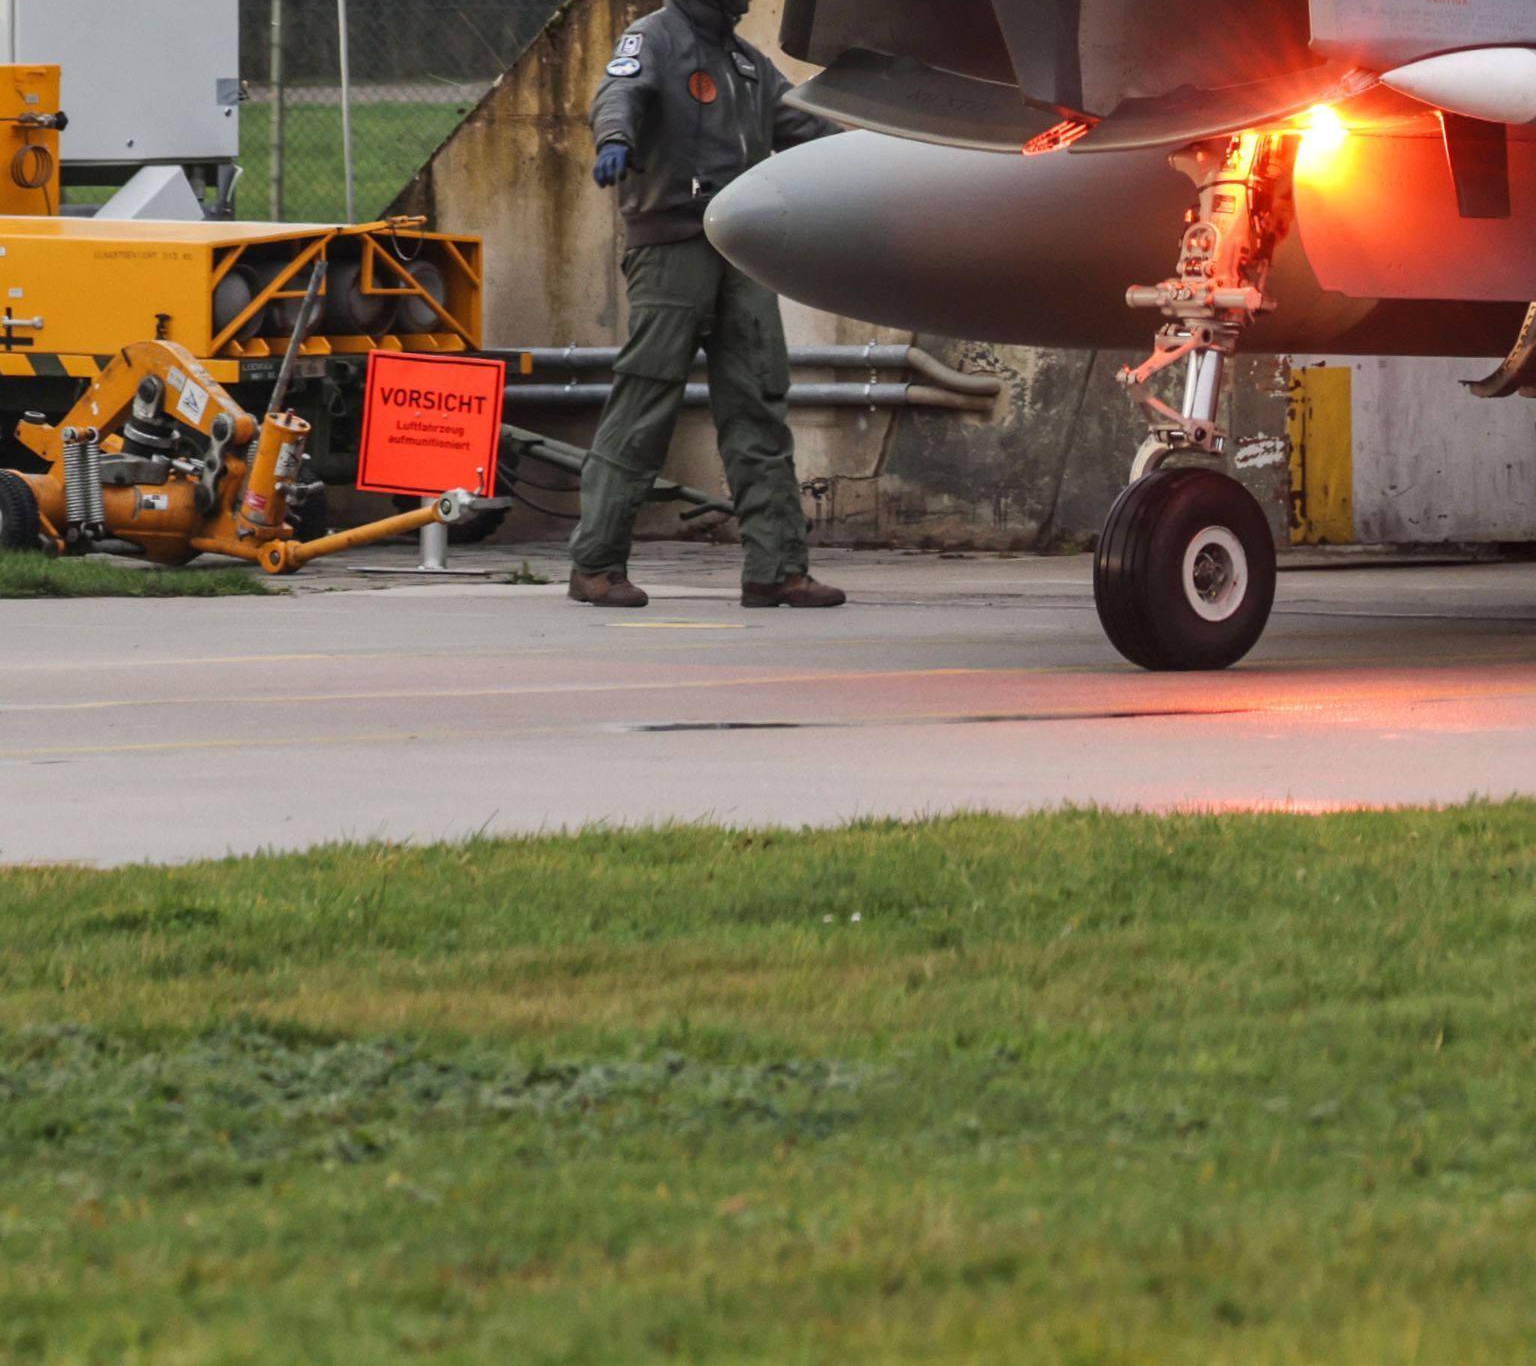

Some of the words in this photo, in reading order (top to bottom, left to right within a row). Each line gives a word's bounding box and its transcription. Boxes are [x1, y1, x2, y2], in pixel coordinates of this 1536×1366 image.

[380, 386, 487, 415] VORSICHT
[396, 419, 465, 437] Luftfahrzeug
[387, 434, 470, 451] aufmunitioniert
